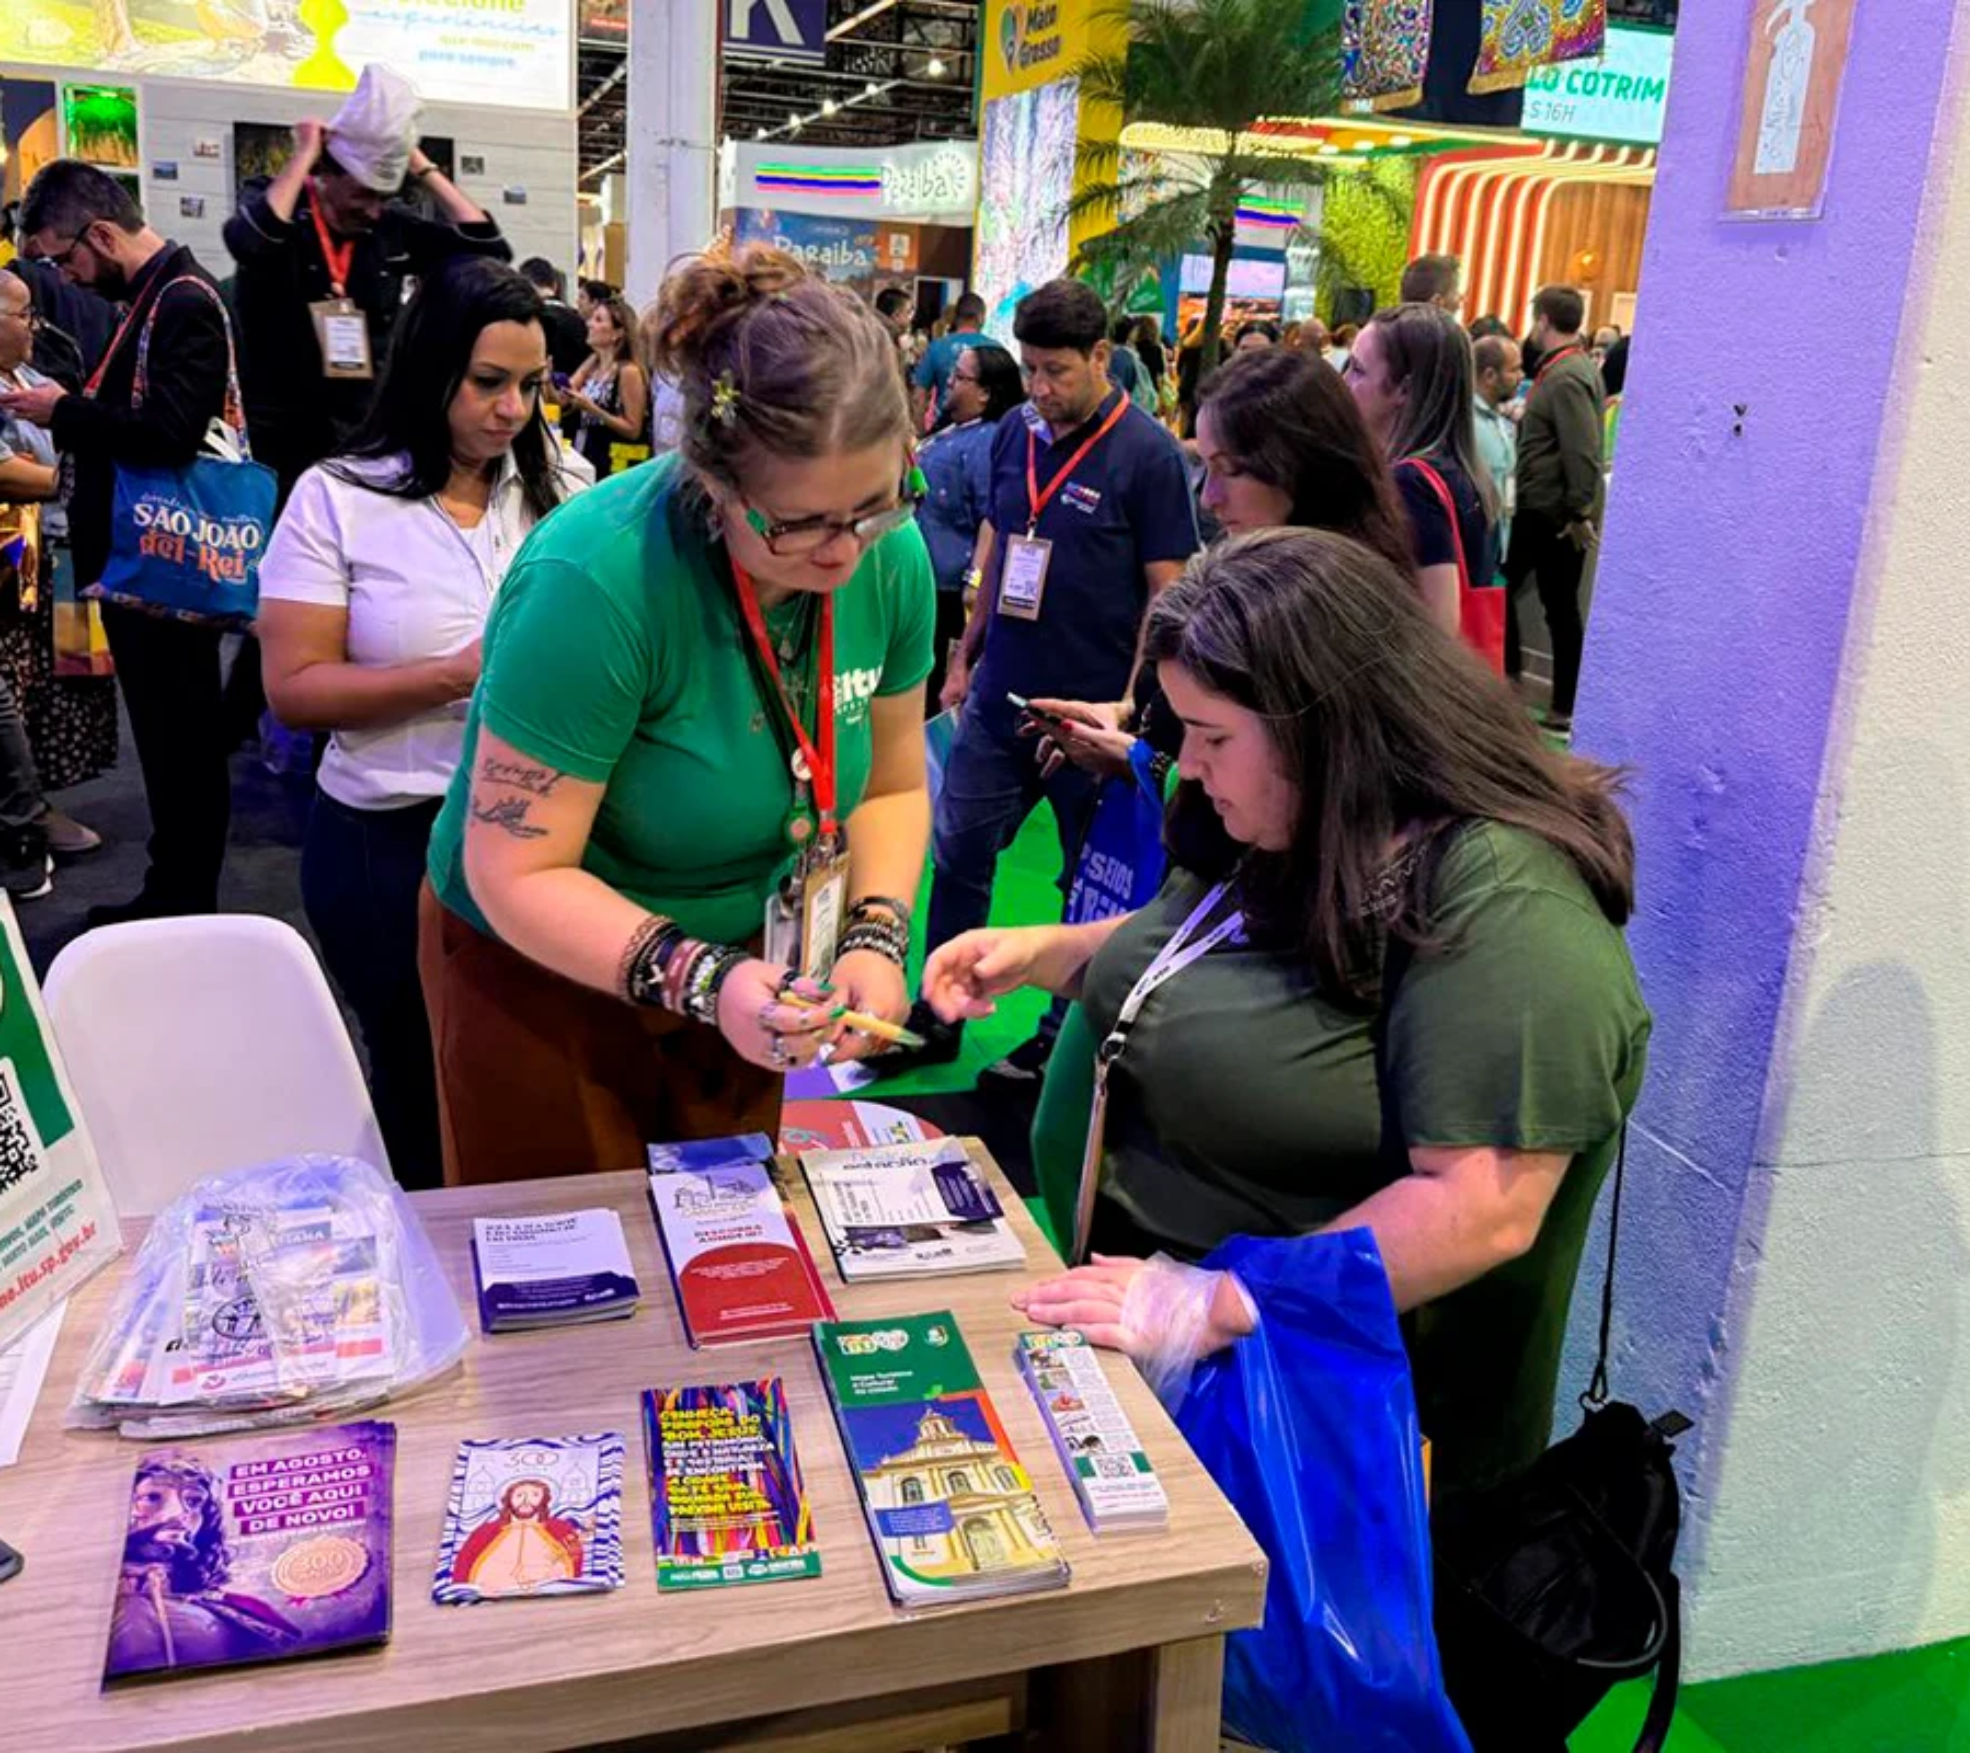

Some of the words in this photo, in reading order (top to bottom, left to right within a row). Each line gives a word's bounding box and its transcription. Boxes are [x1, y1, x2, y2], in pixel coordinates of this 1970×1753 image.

[1566, 69, 1666, 104] COTRIM
[1545, 102, 1576, 122] 16H
[233, 1465, 371, 1496] ESPERAMOS
[235, 1463, 268, 1478] EM
[241, 1491, 303, 1514] VOCÊ
[307, 1484, 362, 1504] AQUI
[249, 1517, 280, 1533] DE
[285, 1504, 355, 1527] NOVO!
